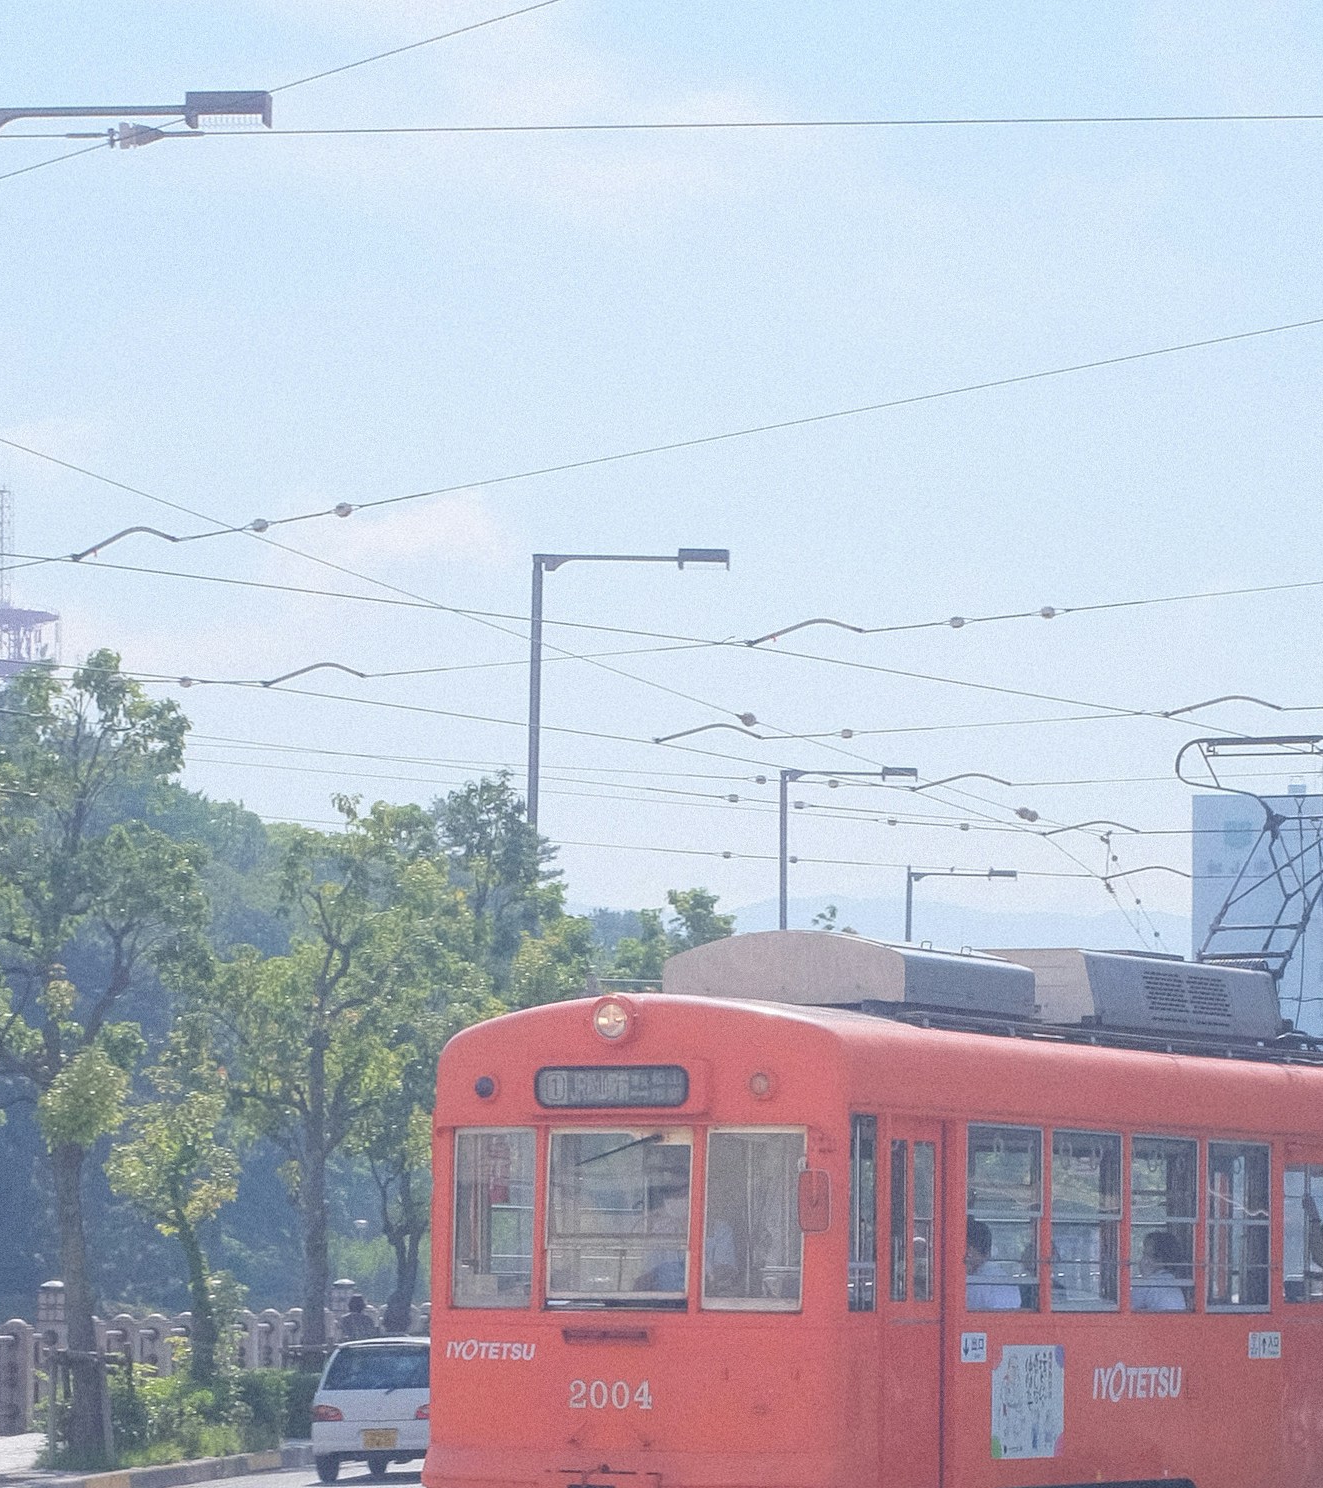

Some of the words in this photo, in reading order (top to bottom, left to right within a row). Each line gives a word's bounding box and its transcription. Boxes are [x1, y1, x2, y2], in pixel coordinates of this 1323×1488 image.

[445, 1338, 536, 1361] IYOTETSU
[971, 1337, 985, 1351] 出口
[1267, 1336, 1279, 1348] 入口
[1092, 1361, 1182, 1403] IYOTETSU
[568, 1379, 653, 1409] 2004
